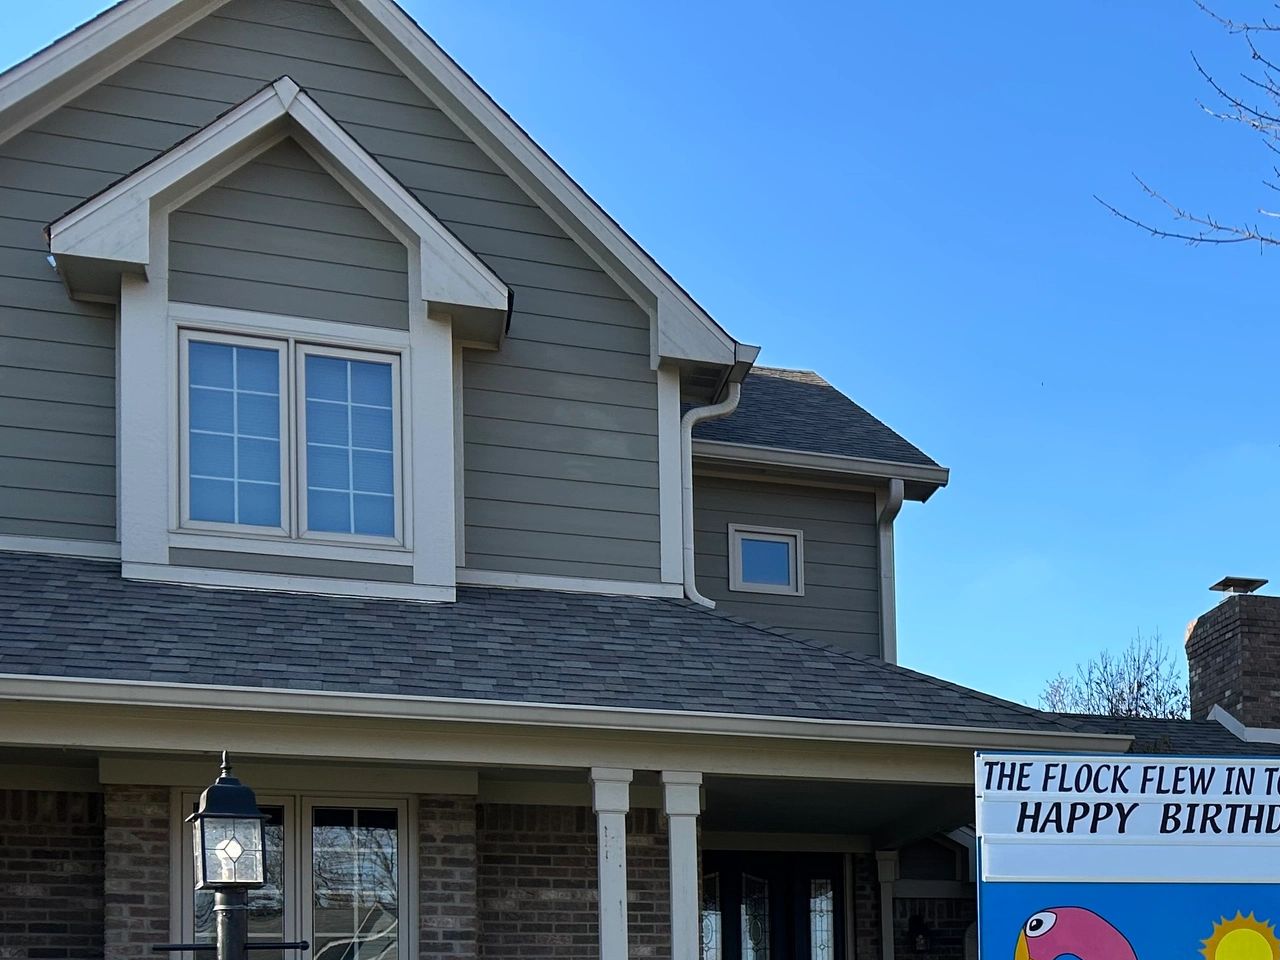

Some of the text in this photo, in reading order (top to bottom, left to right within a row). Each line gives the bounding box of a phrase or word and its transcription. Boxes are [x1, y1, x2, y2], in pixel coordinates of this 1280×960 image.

[984, 761, 1033, 792] THE
[1042, 763, 1131, 794] FLOCK
[1140, 765, 1215, 795] FLEW
[1223, 767, 1255, 795] IN
[1016, 801, 1139, 834] HAPPY
